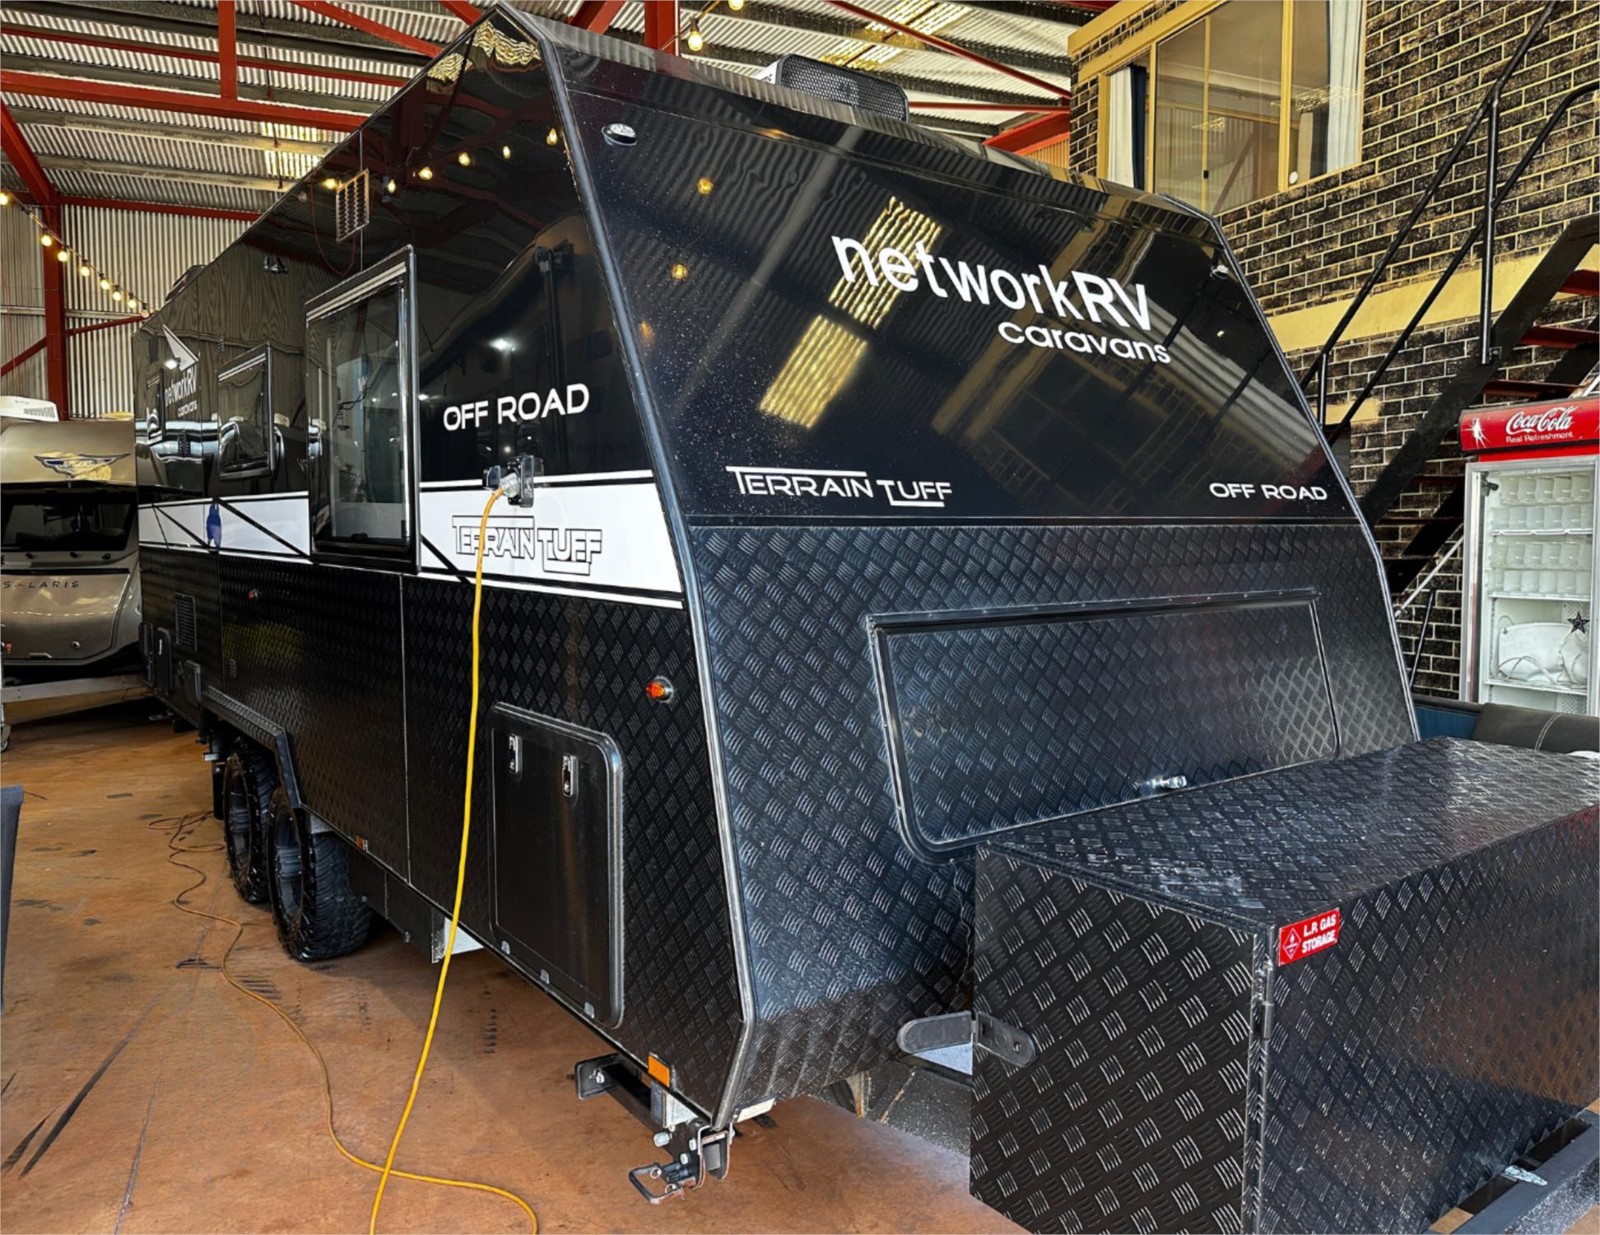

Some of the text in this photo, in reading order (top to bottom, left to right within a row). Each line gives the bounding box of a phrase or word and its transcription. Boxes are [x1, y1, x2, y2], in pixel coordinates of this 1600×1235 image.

[832, 234, 1151, 332] networkRV
[998, 322, 1171, 364] caravans
[443, 383, 590, 431] OFF ROAD
[1506, 431, 1573, 443] Real Refreshment
[725, 465, 953, 507] TERRAIN TUFF
[1209, 482, 1328, 500] OFF ROAD
[537, 528, 602, 576] TUFF
[1301, 929, 1336, 954] STORAGE
[1319, 914, 1336, 931] GAS
